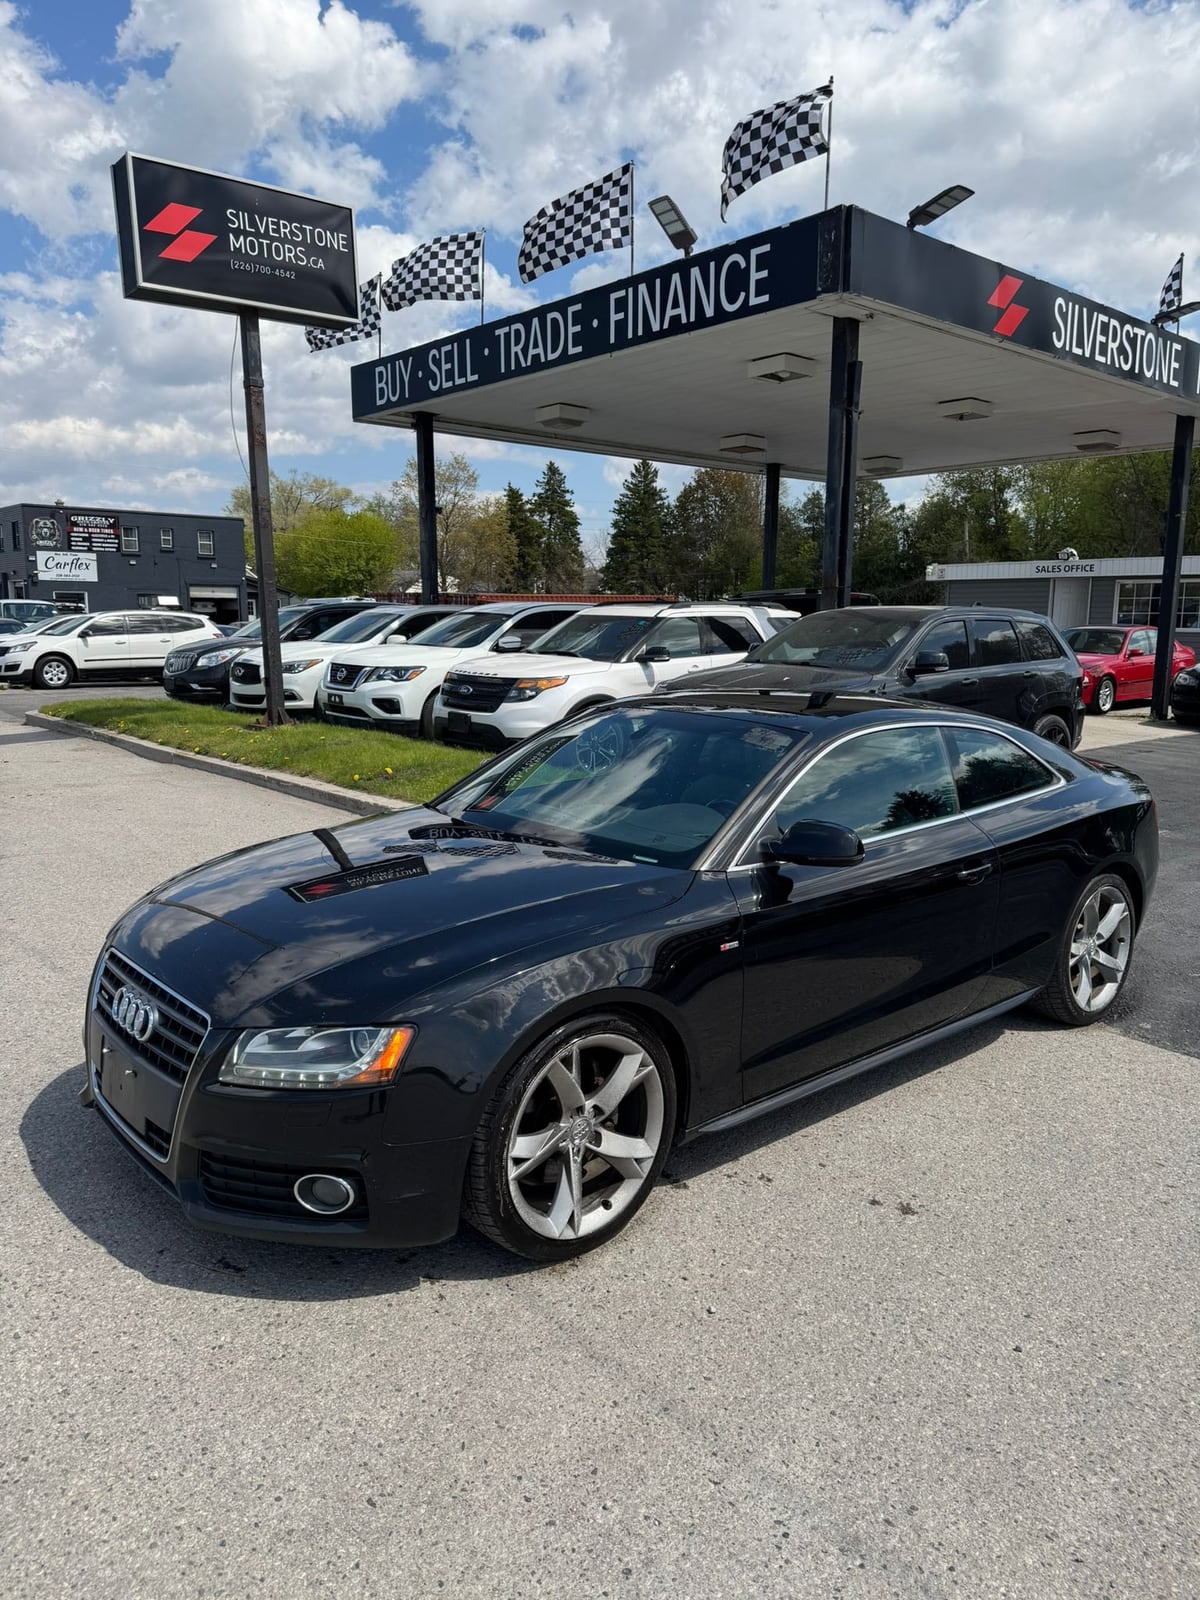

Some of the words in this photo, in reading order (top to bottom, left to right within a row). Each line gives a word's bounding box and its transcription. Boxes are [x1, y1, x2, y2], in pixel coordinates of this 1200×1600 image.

[226, 208, 349, 252] SILVERSTONE
[229, 233, 325, 270] MOTORS.CA
[230, 259, 296, 280] (226)700-4542
[374, 356, 413, 406] BUY
[428, 338, 479, 392] SELL
[495, 303, 583, 374] TRADE
[609, 243, 771, 345] FINANCE
[1052, 297, 1182, 388] SILVERSTONE
[71, 515, 115, 524] GRIZZLY
[45, 556, 90, 573] Carflex
[1035, 564, 1062, 574] SALES
[1064, 563, 1095, 573] OFFICE
